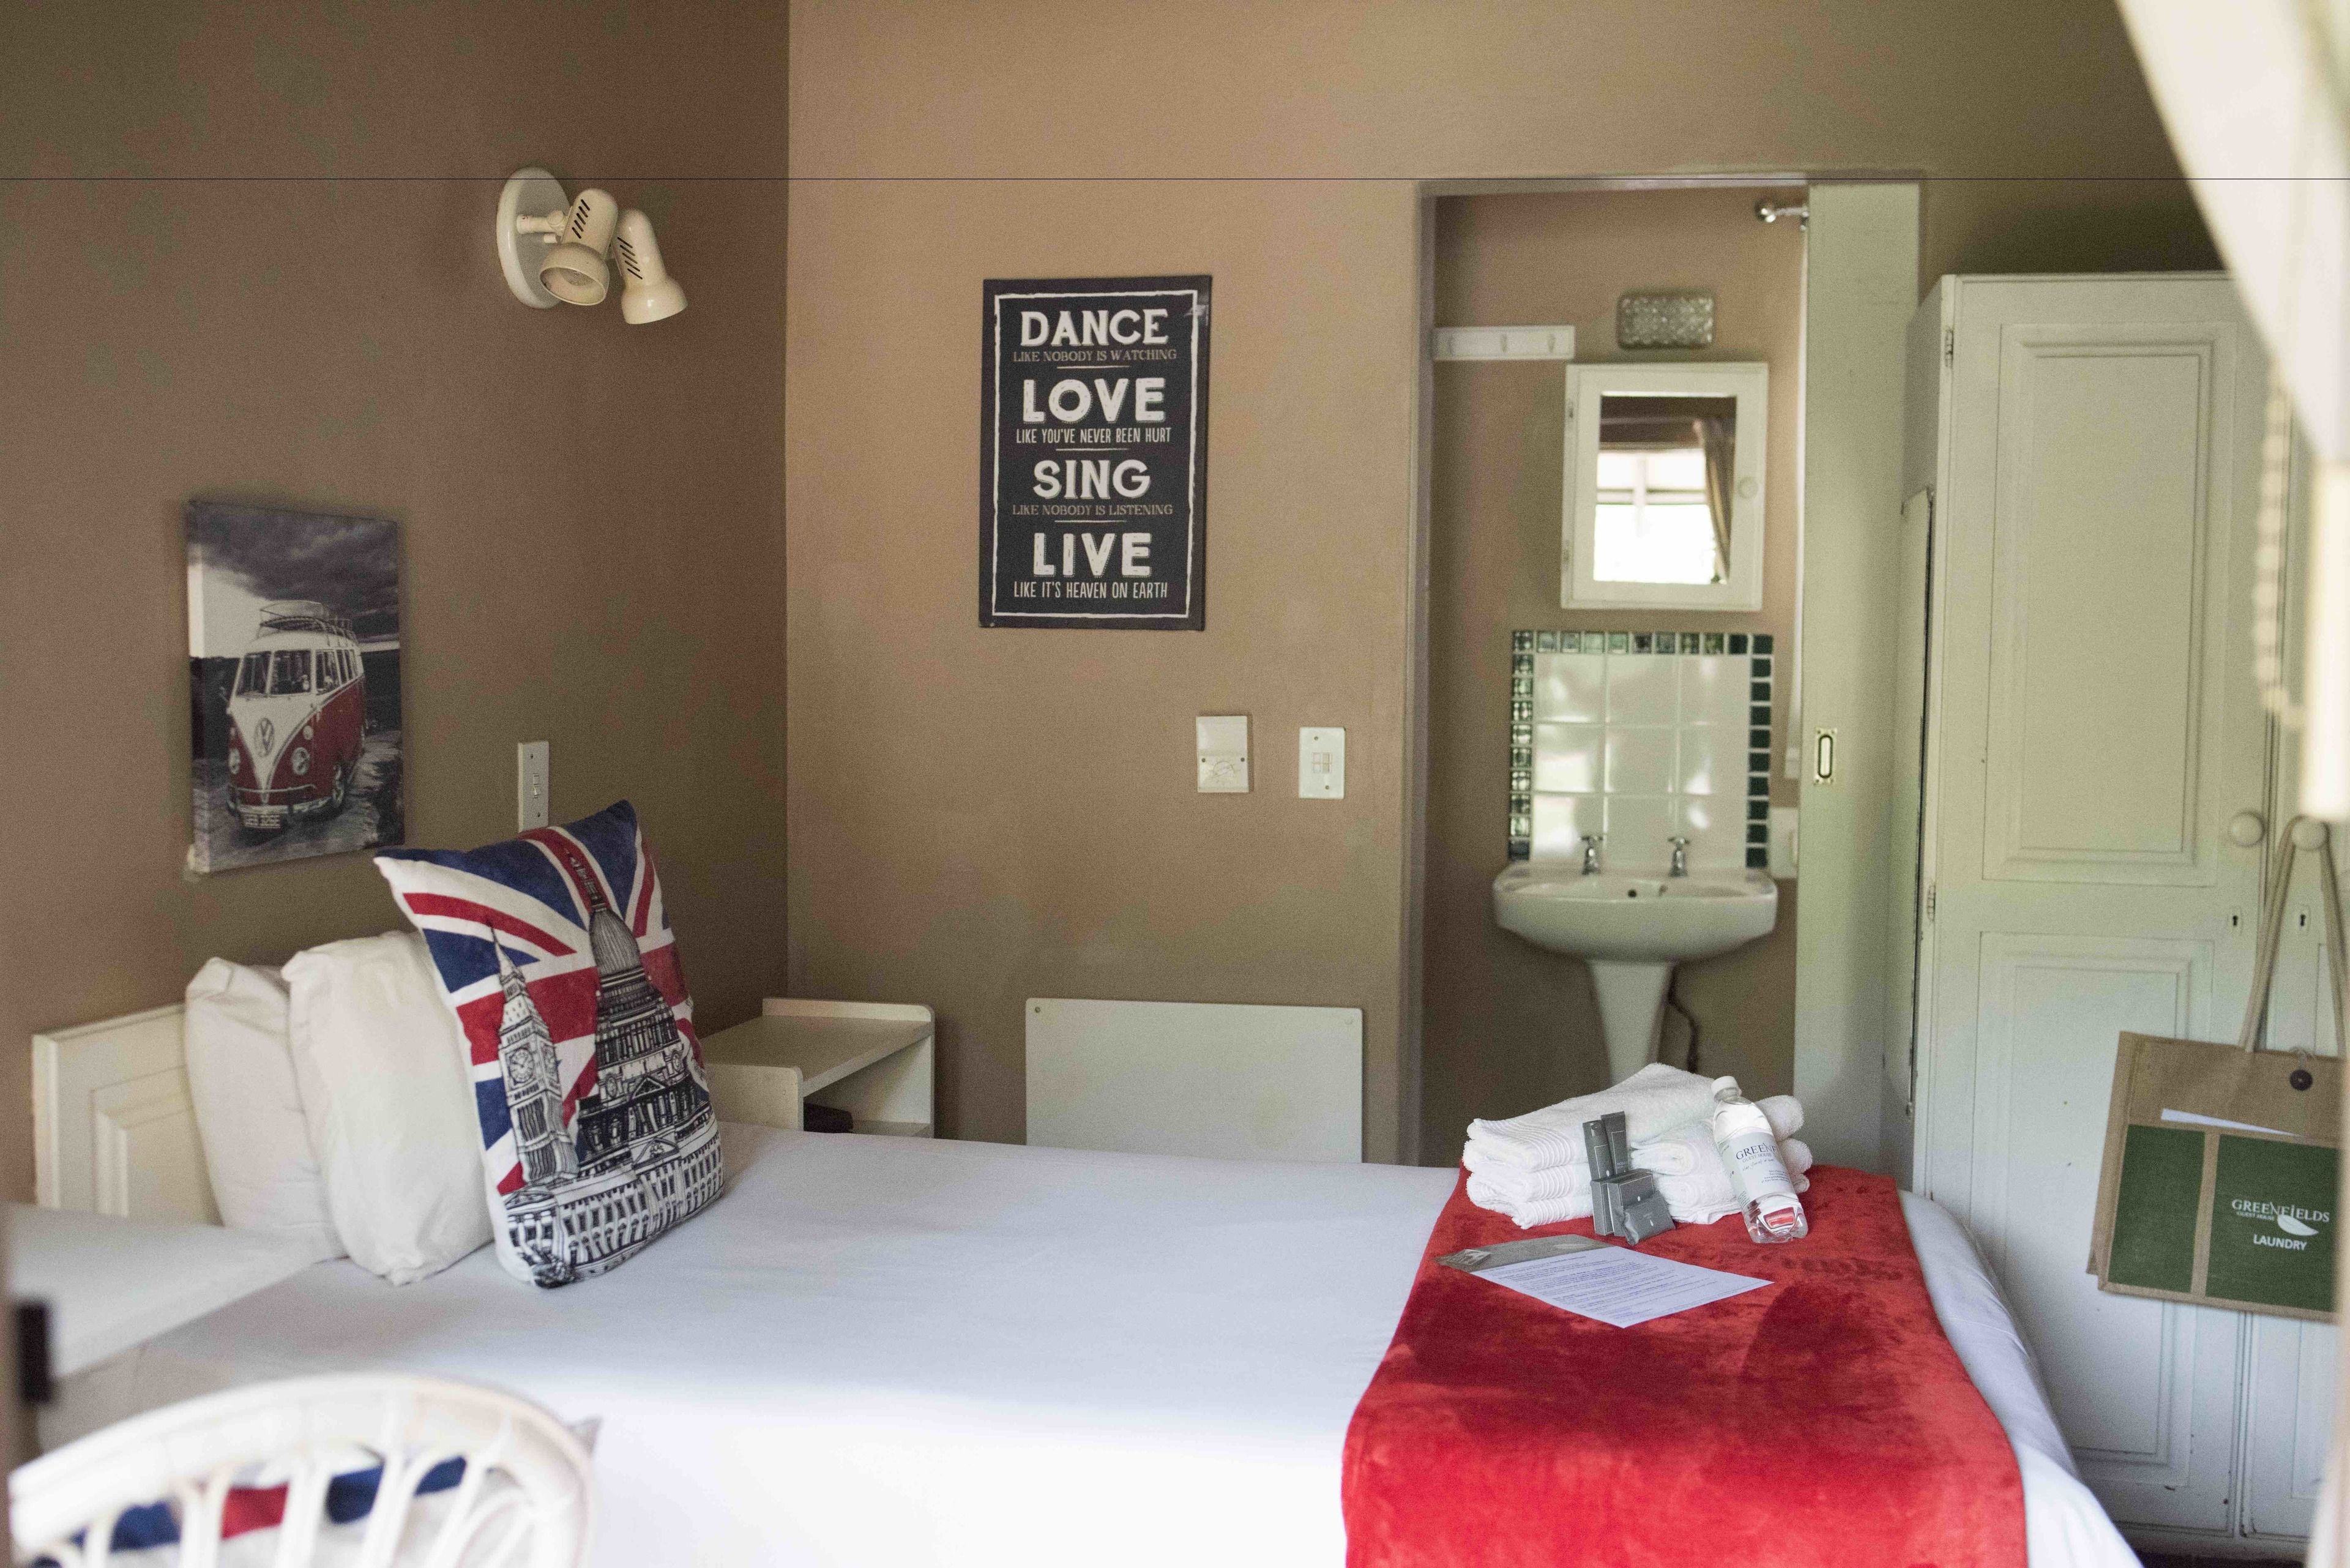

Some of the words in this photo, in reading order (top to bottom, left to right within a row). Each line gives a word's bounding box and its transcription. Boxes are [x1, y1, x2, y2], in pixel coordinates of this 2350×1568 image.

[1020, 308, 1169, 346] DANCE
[1013, 351, 1040, 362] LIKE
[1043, 350, 1093, 362] NOBODY
[1096, 350, 1107, 361] IS
[1110, 349, 1177, 360] WATCHING
[1023, 378, 1166, 424] LOVE
[1016, 428, 1037, 444] LIKE
[1042, 428, 1076, 444] YOU'VE
[1080, 428, 1111, 444] NEVER
[1116, 428, 1141, 443] BEEN
[1145, 427, 1171, 443] HURT
[1032, 459, 1151, 499] SING
[1012, 505, 1039, 515] LIKE
[1042, 505, 1090, 516] NOBODY
[1095, 505, 1106, 515] IS
[1109, 504, 1173, 515] LISTENING
[1033, 532, 1152, 578] LIVE
[1014, 581, 1037, 598] LIKE
[1042, 581, 1061, 598] IT'S
[1066, 582, 1107, 599] HEAVEN
[1111, 582, 1128, 599] ON
[1133, 582, 1168, 599] EARTH
[2231, 1199, 2330, 1223] GREENFIELDS
[2253, 1234, 2308, 1251] LAUNDRY
